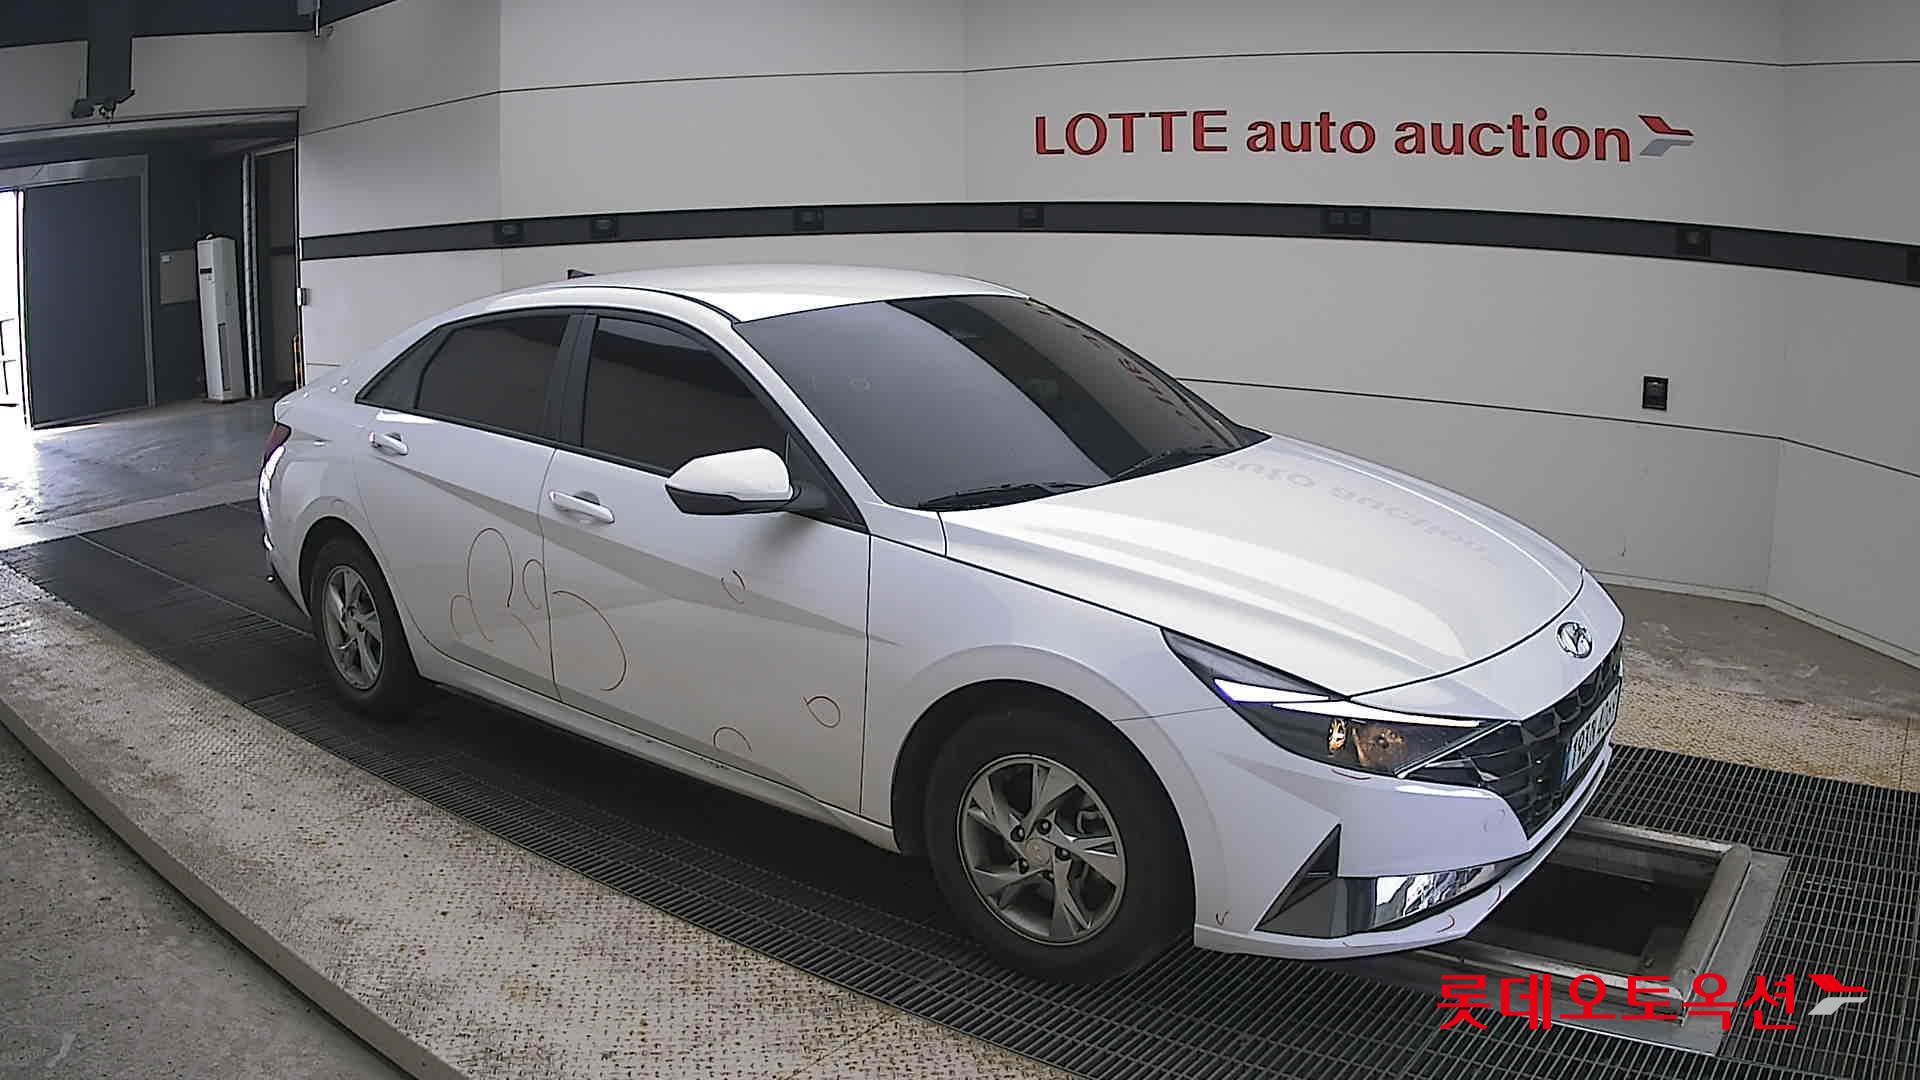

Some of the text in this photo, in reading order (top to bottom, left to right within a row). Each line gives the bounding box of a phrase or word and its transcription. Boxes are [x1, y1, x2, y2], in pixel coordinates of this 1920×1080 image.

[1034, 107, 1632, 162] LOTTE auto auction
